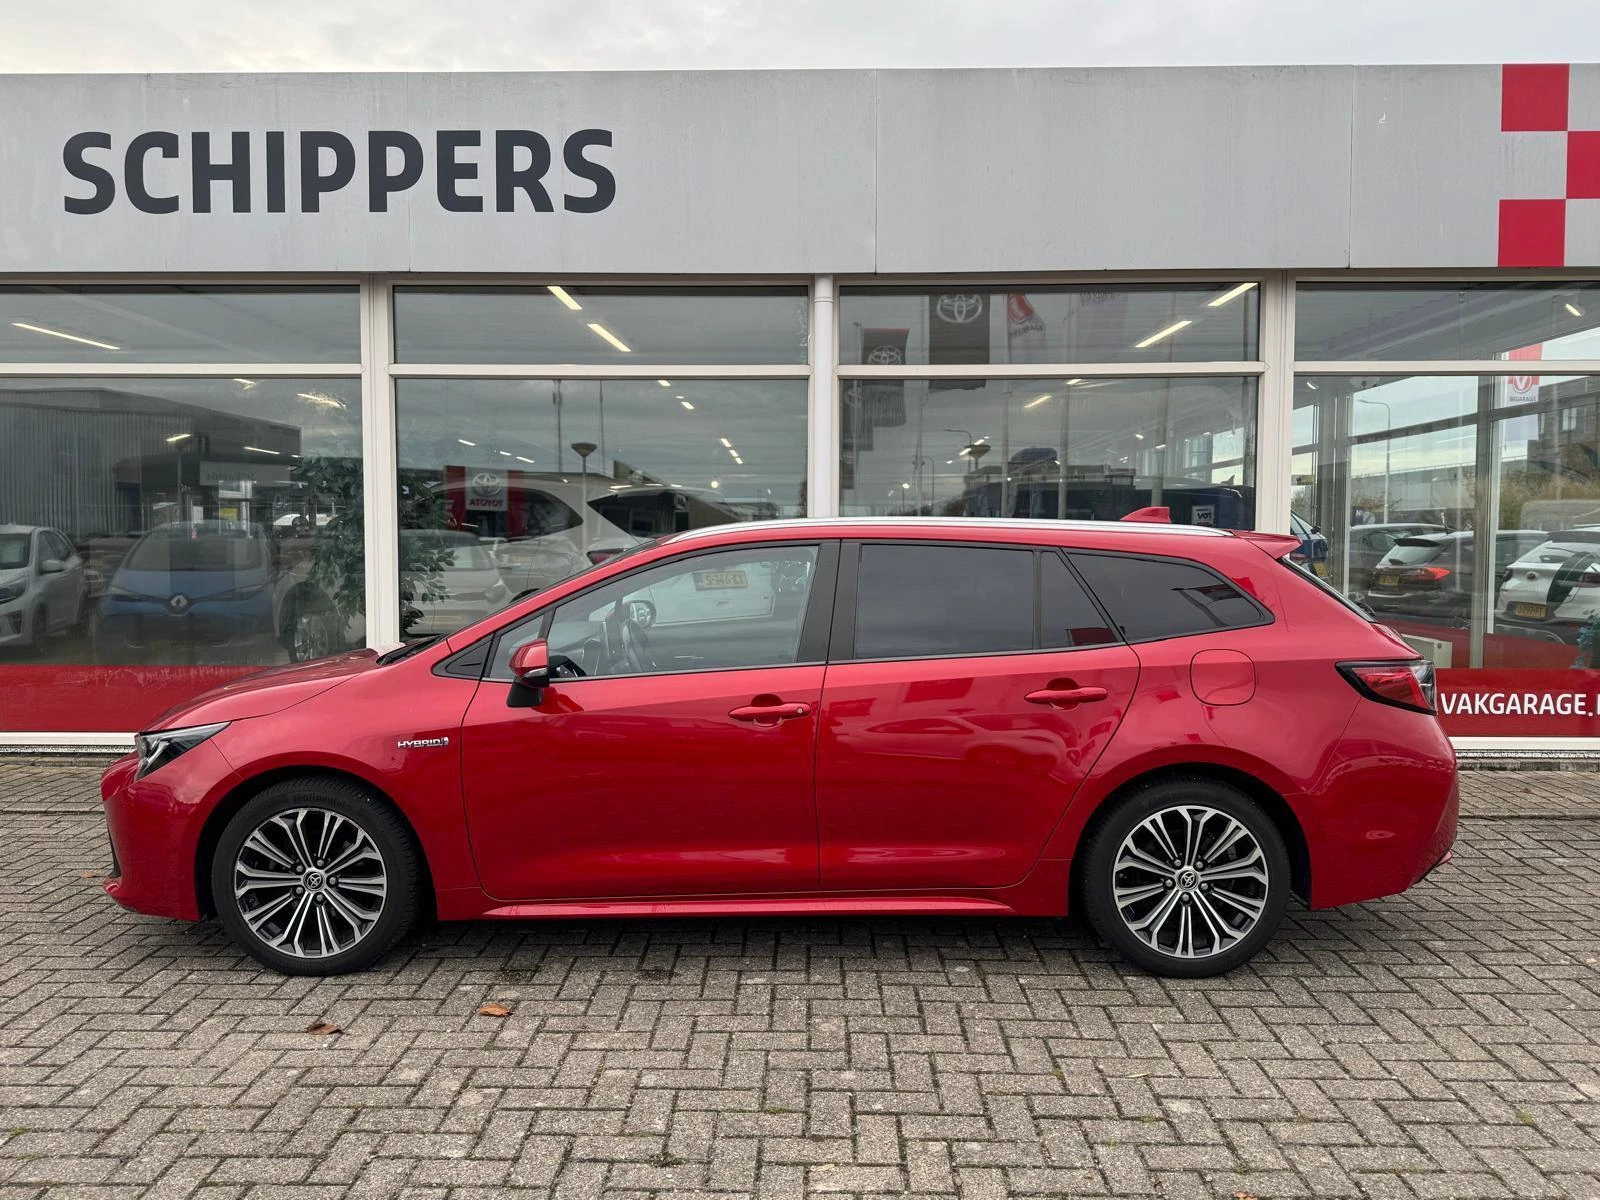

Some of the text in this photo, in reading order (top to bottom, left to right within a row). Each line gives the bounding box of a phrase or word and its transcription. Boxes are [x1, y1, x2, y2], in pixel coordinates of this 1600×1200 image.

[62, 128, 617, 215] SCHIPPERS
[1440, 692, 1600, 717] VAKGARAGE.
[397, 738, 442, 748] HYBRID
